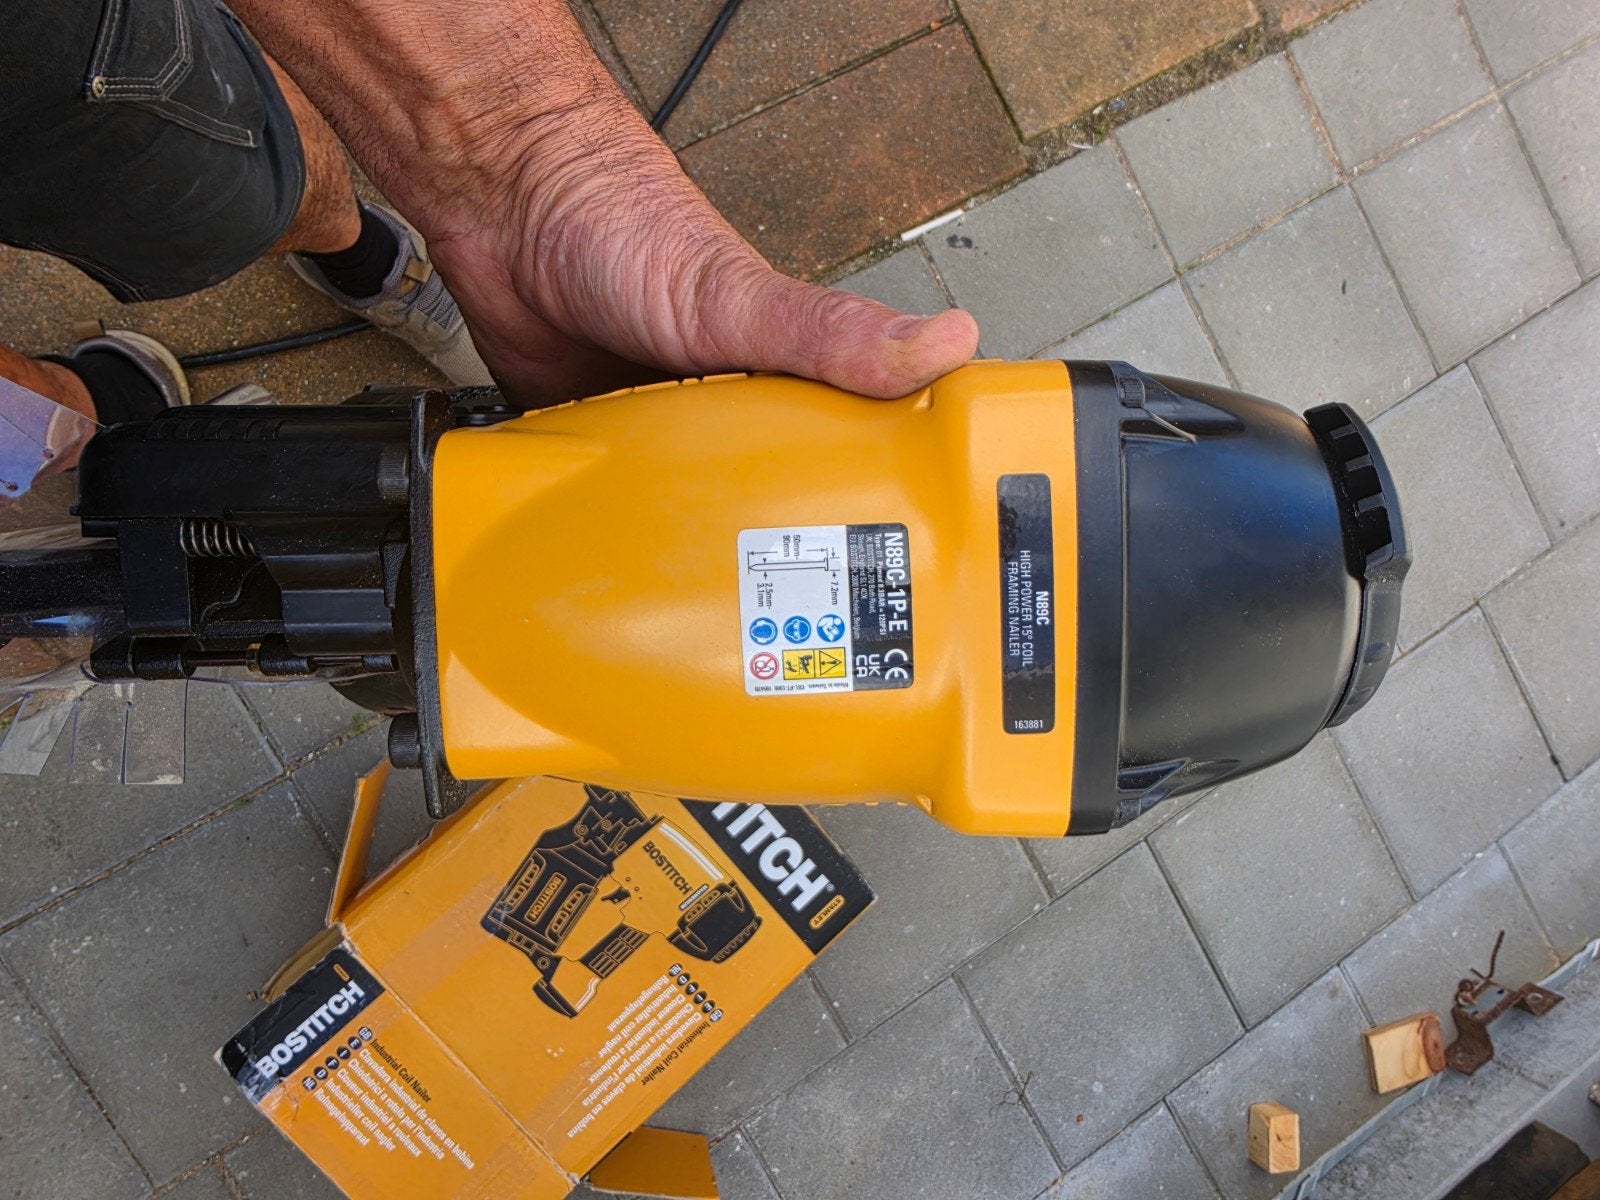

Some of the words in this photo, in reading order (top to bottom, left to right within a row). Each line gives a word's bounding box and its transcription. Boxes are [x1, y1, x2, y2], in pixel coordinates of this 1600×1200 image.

[783, 535, 791, 557] 90mm
[1020, 551, 1031, 578] HIGH
[831, 582, 839, 605] 7.2mm
[884, 533, 908, 632] N89C-1P-E
[1007, 562, 1019, 613] FRAMING
[1021, 581, 1032, 620] POWER
[1036, 591, 1049, 625] N89C
[1008, 616, 1020, 656] NAILER
[869, 654, 880, 676] UK
[1022, 642, 1033, 667] COIL
[1014, 720, 1043, 729] 163881
[642, 840, 691, 895] BOSTITCH
[710, 802, 829, 912] ITCH
[528, 875, 561, 918] BOSTITCH
[812, 897, 841, 924] STANLEY
[669, 964, 681, 975] NL
[656, 993, 685, 1020] Cloueur
[254, 979, 365, 1078] BOSTITCH
[620, 1021, 636, 1037] coil
[676, 1020, 710, 1052] Industrial
[359, 1027, 371, 1039] GB
[369, 1038, 401, 1070] Industrial
[398, 1067, 414, 1083] Coil
[410, 1080, 431, 1102] Nailer
[629, 1041, 651, 1062] rotolo
[634, 1042, 668, 1075] industrial
[662, 1050, 678, 1066] Coil
[616, 1058, 630, 1074] per
[624, 1072, 635, 1083] de
[640, 1063, 665, 1086] Nailer
[303, 1077, 315, 1089] NL
[601, 1081, 626, 1105] clavos
[384, 1097, 405, 1118] rotolo
[400, 1115, 415, 1130] per
[388, 1079, 420, 1111] industrial
[416, 1108, 428, 1119] de
[424, 1116, 447, 1140] clavos
[443, 1137, 454, 1148] en
[591, 1103, 602, 1114] en
[567, 1112, 594, 1138] bobina
